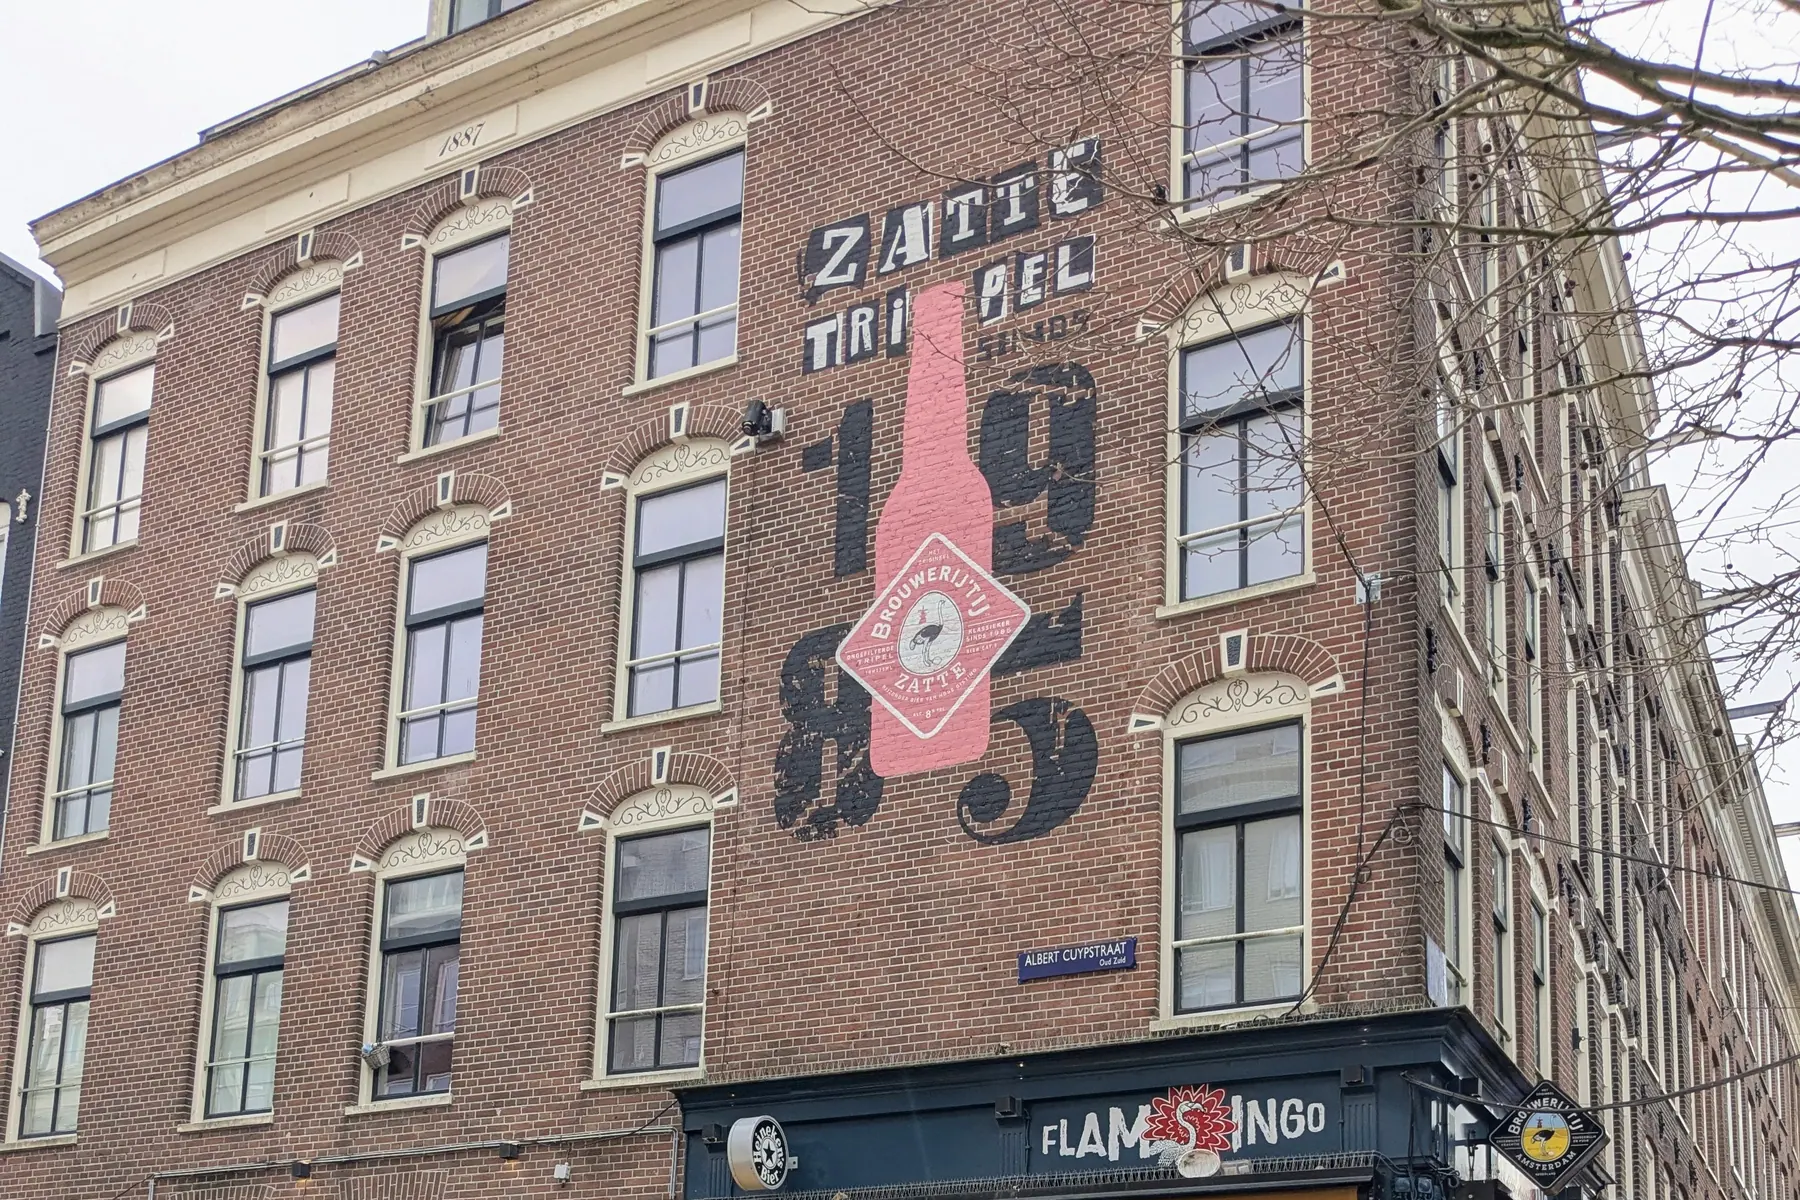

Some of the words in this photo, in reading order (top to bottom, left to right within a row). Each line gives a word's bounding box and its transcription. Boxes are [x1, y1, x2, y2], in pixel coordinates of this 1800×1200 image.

[439, 121, 486, 157] 1887
[813, 133, 1099, 287] ZATTE
[856, 653, 894, 666] TRIPEL
[894, 662, 966, 693] ZATTE
[1024, 951, 1059, 967] ALBERT
[1062, 942, 1127, 961] CUYPSTRAAT
[1099, 958, 1111, 967] Oud
[1113, 956, 1126, 965] Zuid
[754, 1125, 785, 1168] Heineken's
[1515, 1151, 1577, 1171] AMSTERDAM
[761, 1165, 778, 1184] Bier
